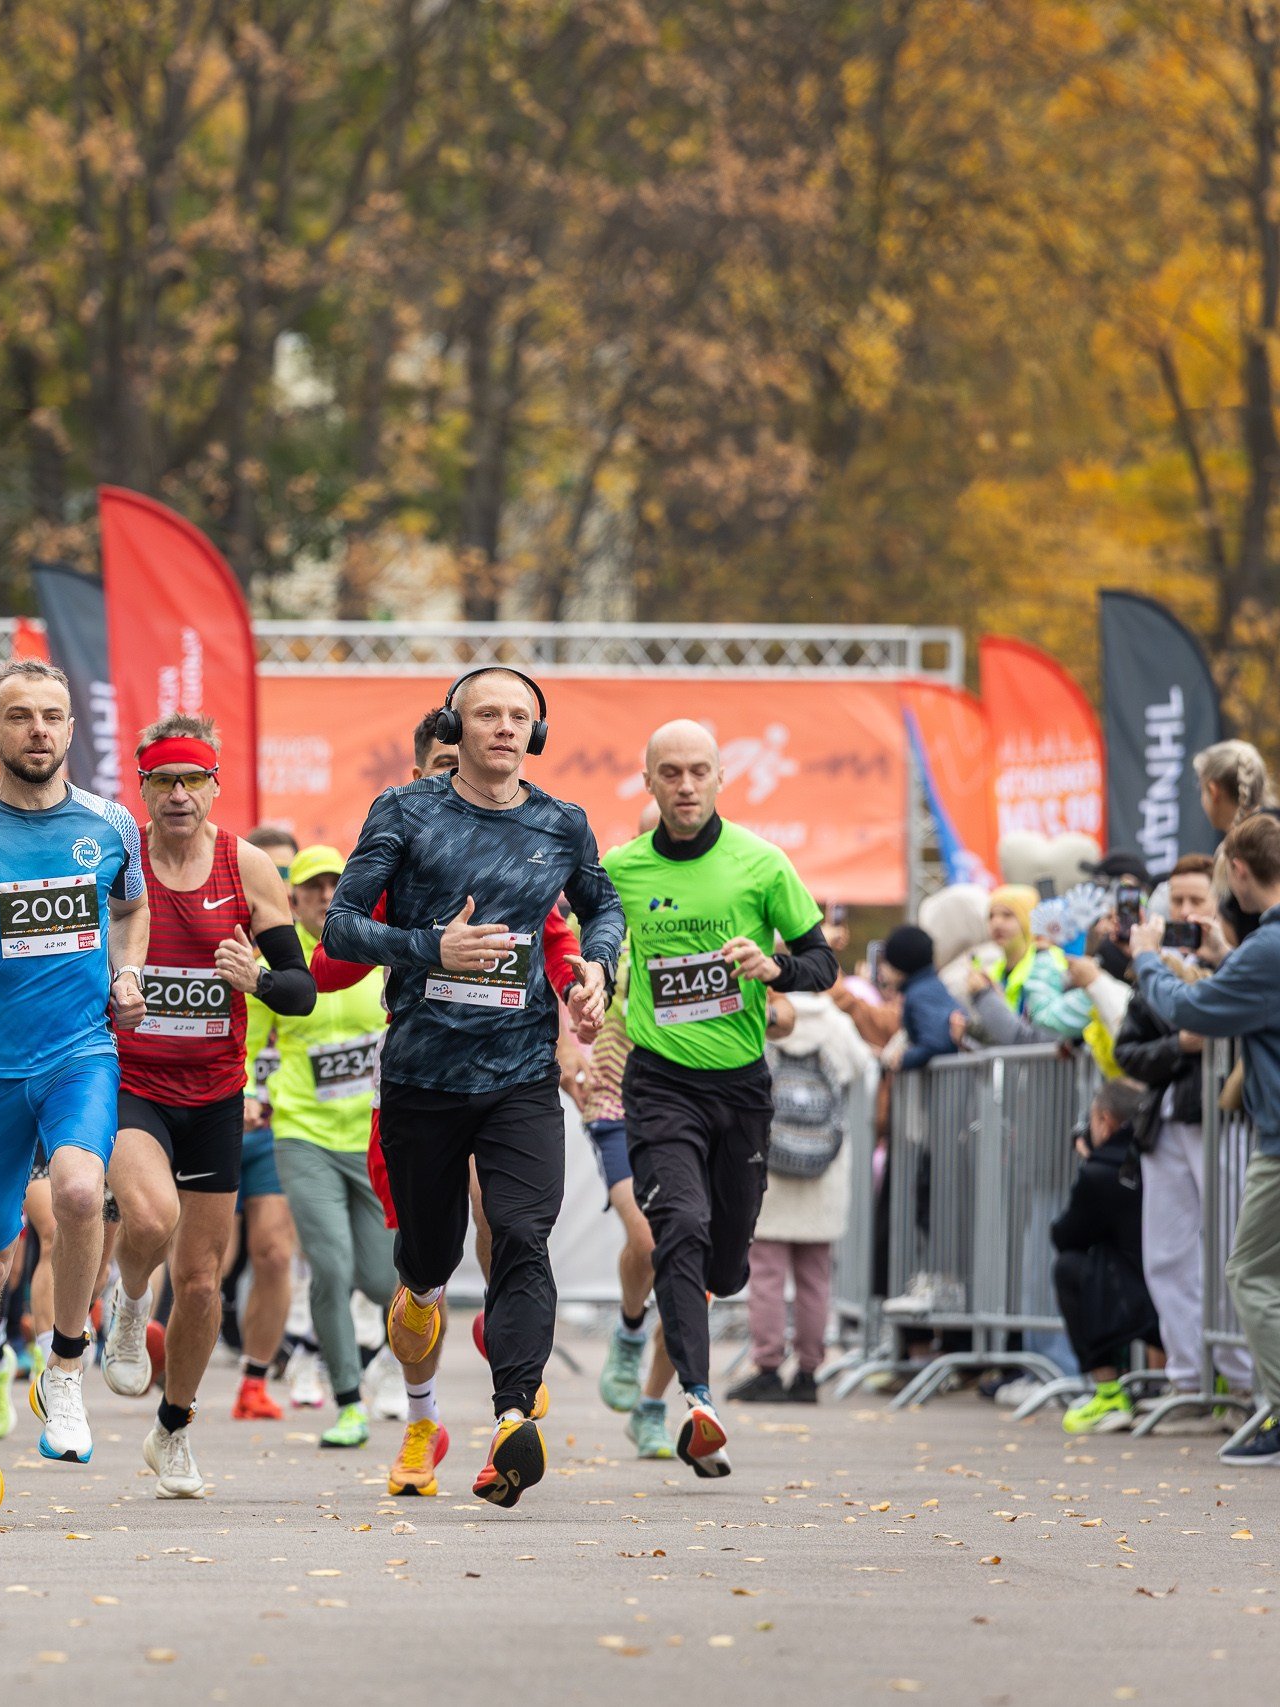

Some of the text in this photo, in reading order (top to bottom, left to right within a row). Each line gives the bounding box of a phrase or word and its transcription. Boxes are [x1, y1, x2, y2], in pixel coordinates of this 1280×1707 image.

[10, 893, 91, 924] 2001
[640, 919, 731, 935] К-ХОЛДИНГ
[44, 941, 55, 949] 4.2
[145, 980, 225, 1007] 2060
[660, 966, 728, 996] 2149
[319, 1048, 376, 1077] 2234
